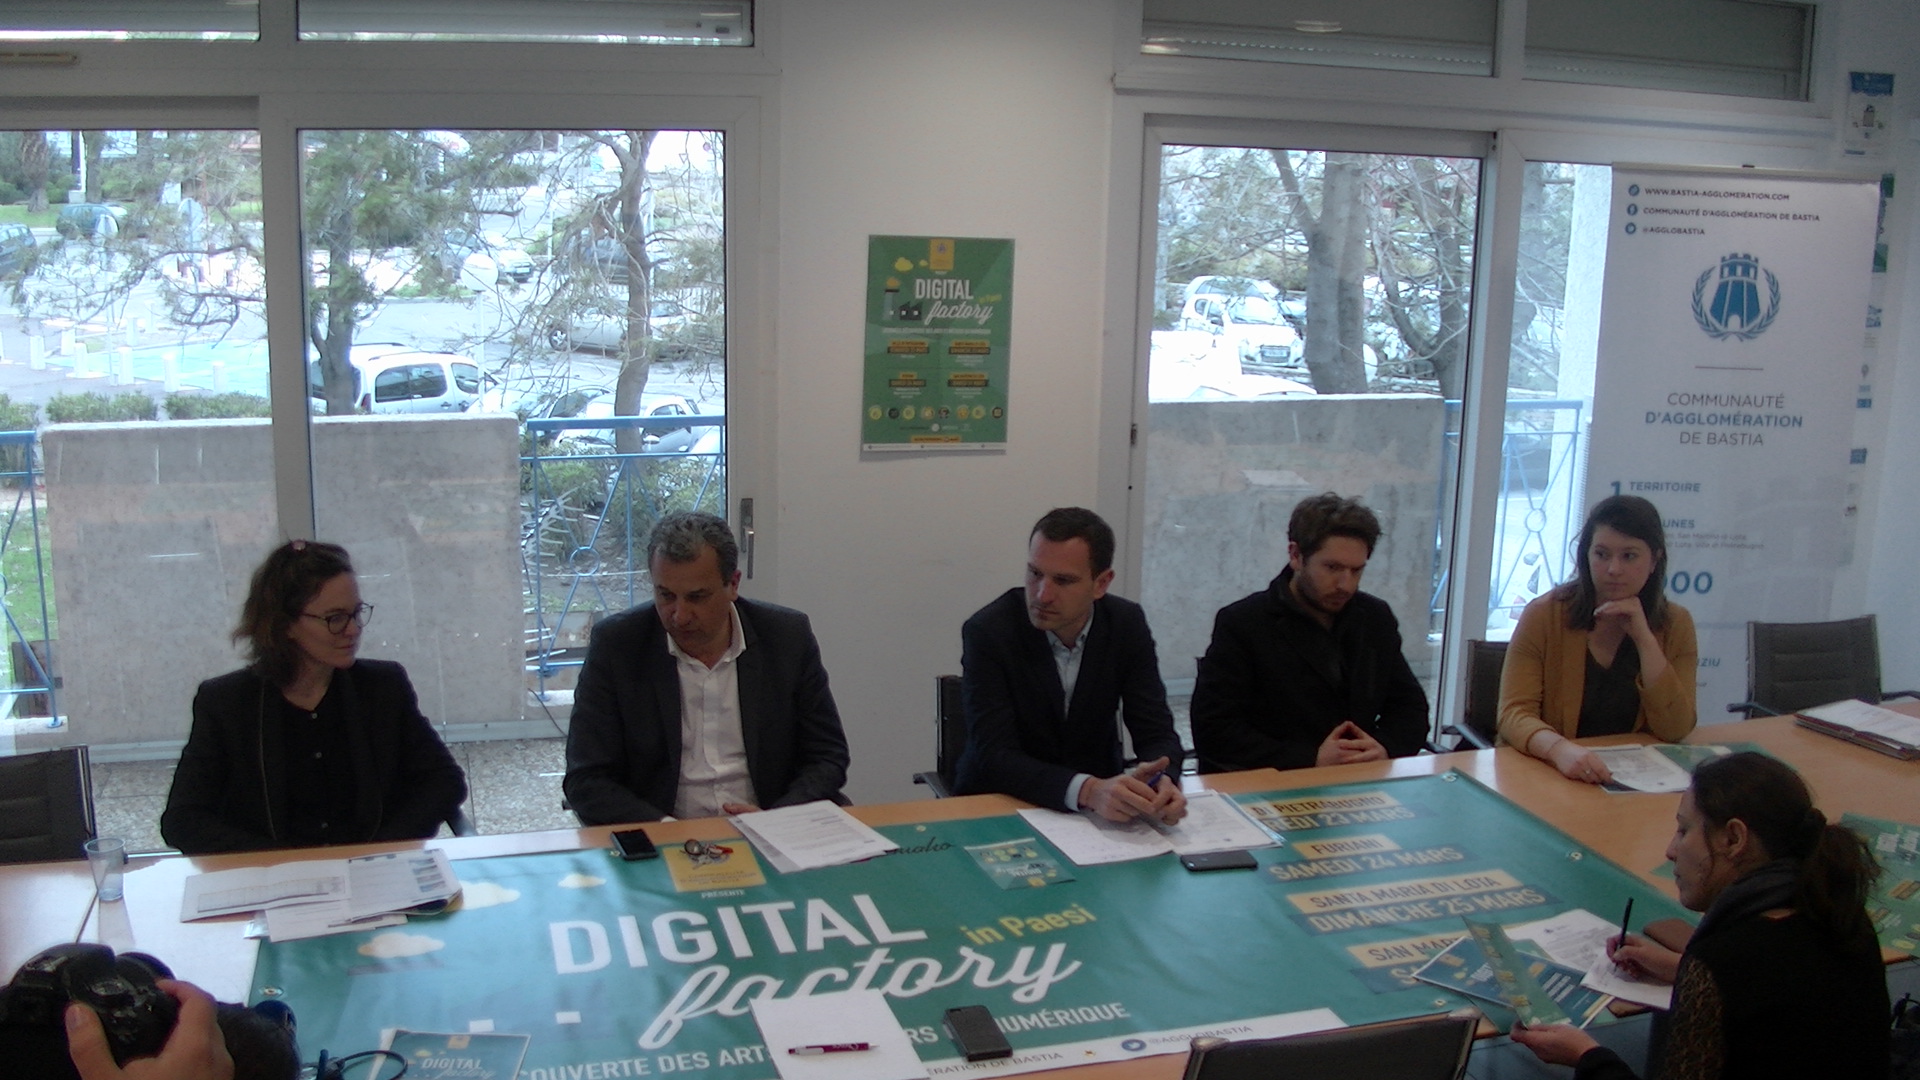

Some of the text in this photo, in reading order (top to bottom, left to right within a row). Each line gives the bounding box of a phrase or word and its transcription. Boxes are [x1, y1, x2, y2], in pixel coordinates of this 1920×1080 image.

[1645, 188, 1790, 200] WWW.BASTIA-AGGLOMERATION.COM
[1642, 206, 1700, 216] COMMUNAUTÉ
[1702, 208, 1778, 219] D'AGGLOMÉRATION
[1792, 213, 1820, 221] BASTIA
[1642, 227, 1705, 236] @AGGLOBASTIA
[915, 278, 974, 299] DIGITAL
[924, 300, 994, 325] factory
[1667, 392, 1785, 408] COMMUNAUTÉ
[1645, 411, 1803, 427] D'AGGLOMÉRATION
[1679, 432, 1764, 446] DE BASTIA
[1629, 481, 1701, 493] TERRITOIRE
[1662, 519, 1695, 528] UNES
[1664, 571, 1713, 594] 00
[1250, 796, 1386, 816] DI PIETRABUGNO
[1264, 807, 1415, 832] REDI 23 MARS
[1311, 838, 1384, 855] FURIANI
[1270, 846, 1464, 880] SAMEDI 24 MARS
[1309, 875, 1502, 908] SANTA MARIA DI LOTA
[1308, 888, 1547, 933] DIMANCHE 25 MARS
[961, 903, 1097, 946] in Paesi
[549, 894, 929, 974] DIGITAL
[1368, 945, 1414, 961] SAN
[638, 942, 1083, 1050] factory
[422, 1057, 483, 1069] DIGITAL
[531, 1057, 652, 1080] OUVERTE
[658, 1051, 710, 1073] DES
[719, 1045, 769, 1066] ART
[989, 1059, 1005, 1069] DE
[1013, 1052, 1064, 1065] BASTIA
